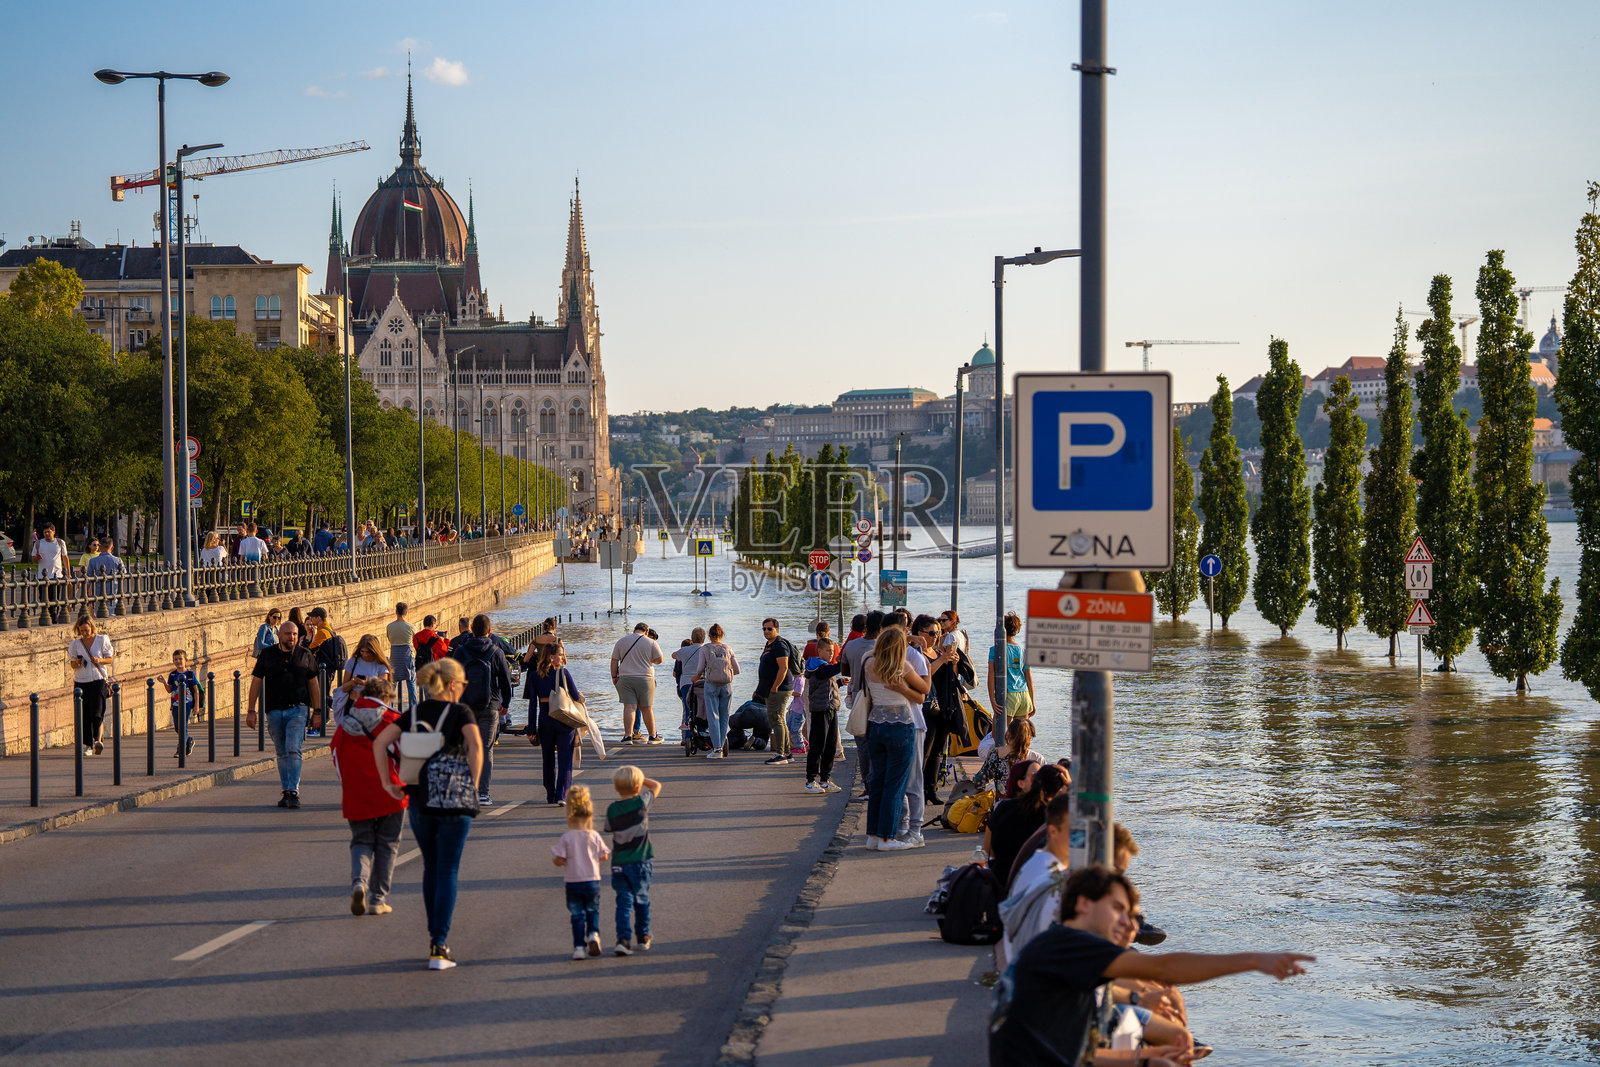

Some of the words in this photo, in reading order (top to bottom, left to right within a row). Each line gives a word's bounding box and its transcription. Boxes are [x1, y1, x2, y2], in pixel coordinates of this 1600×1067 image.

[1059, 412, 1127, 490] P
[1049, 527, 1136, 558] ZNA
[810, 556, 829, 564] STOP
[1064, 599, 1074, 612] A
[1086, 598, 1126, 614] ZÓNA
[1071, 652, 1100, 666] 0501
